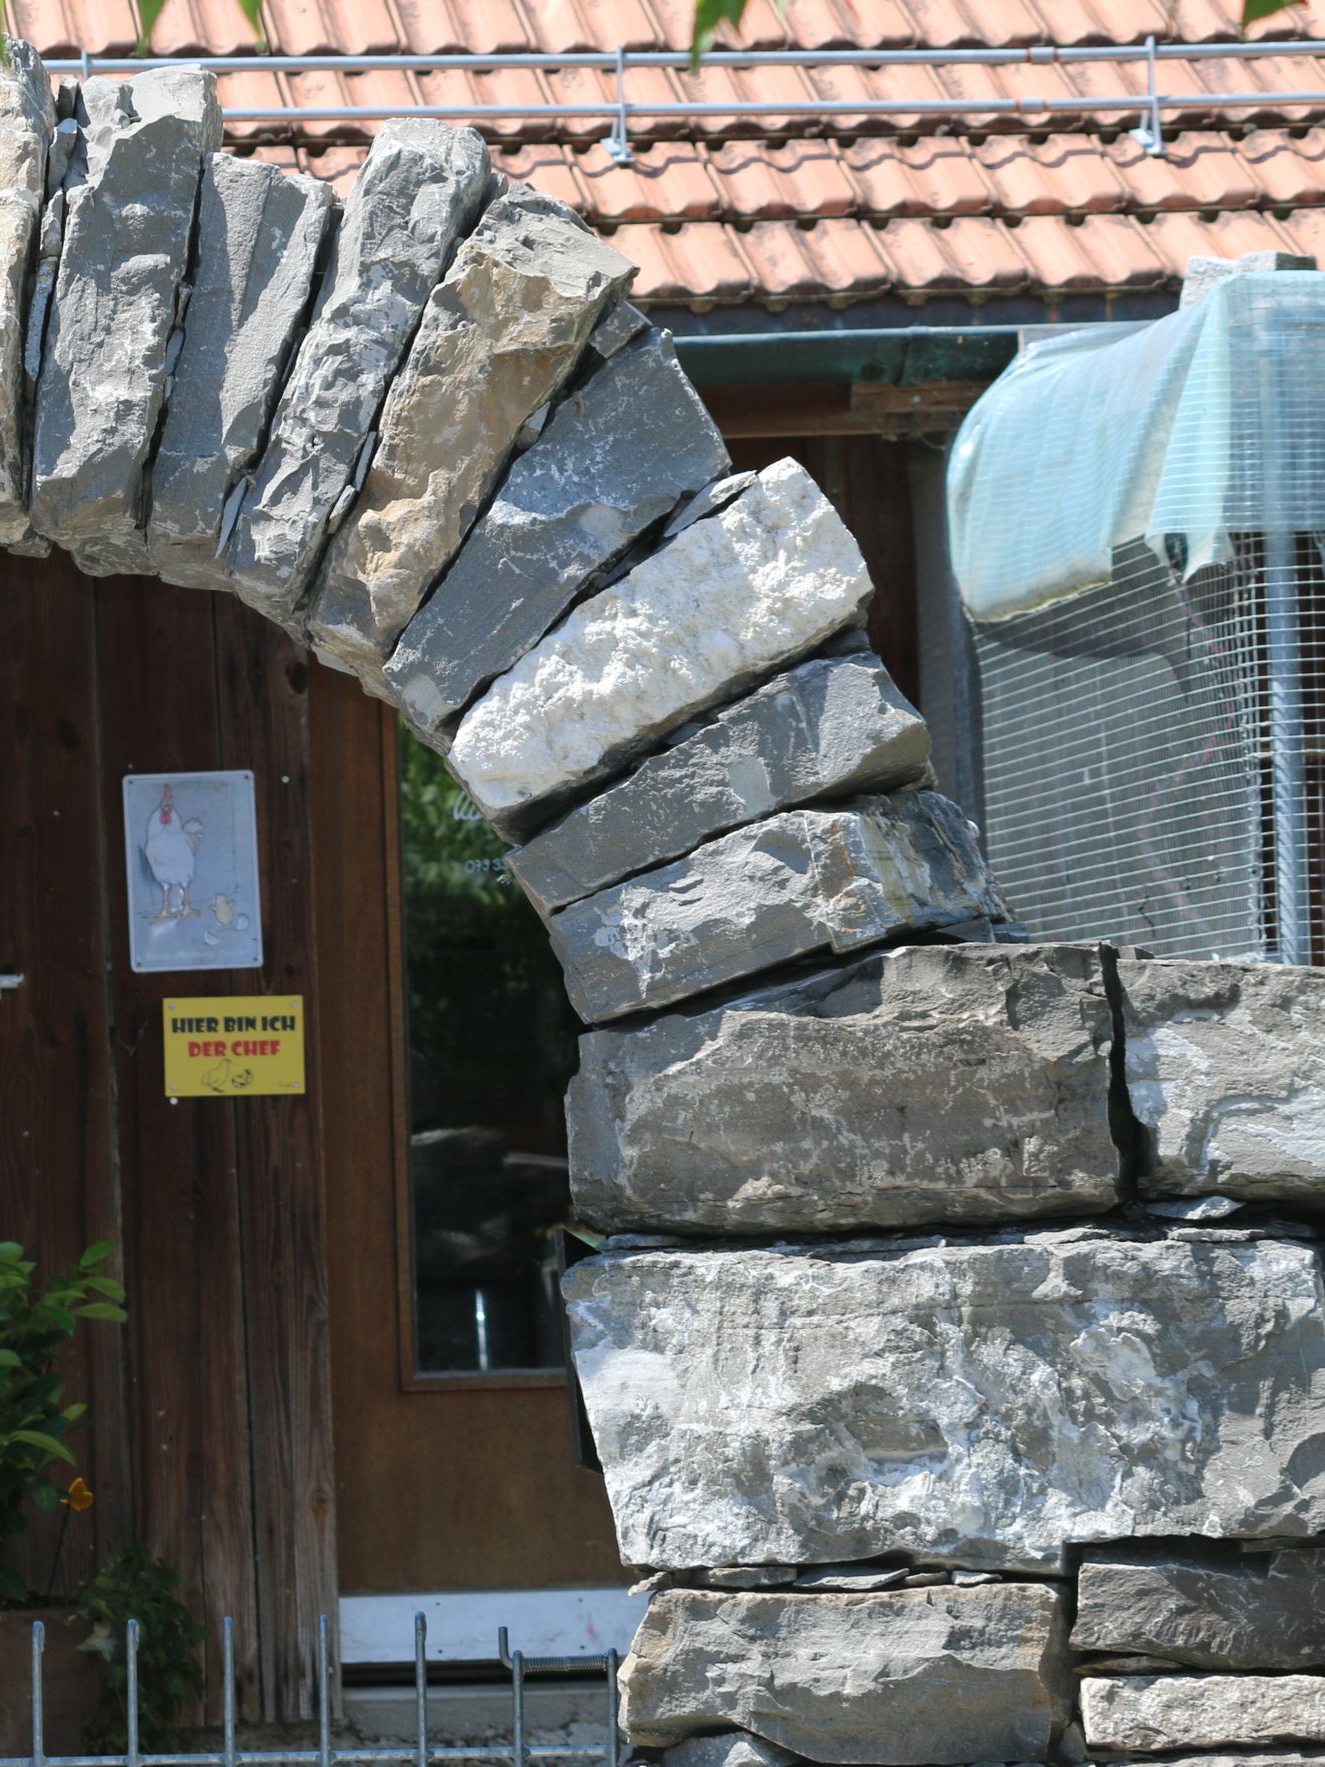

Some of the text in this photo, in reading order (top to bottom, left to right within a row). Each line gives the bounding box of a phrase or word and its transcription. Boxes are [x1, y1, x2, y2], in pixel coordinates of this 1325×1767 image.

[171, 1016, 296, 1033] HIER BIN ICH
[188, 1040, 281, 1057] DER CHEF
